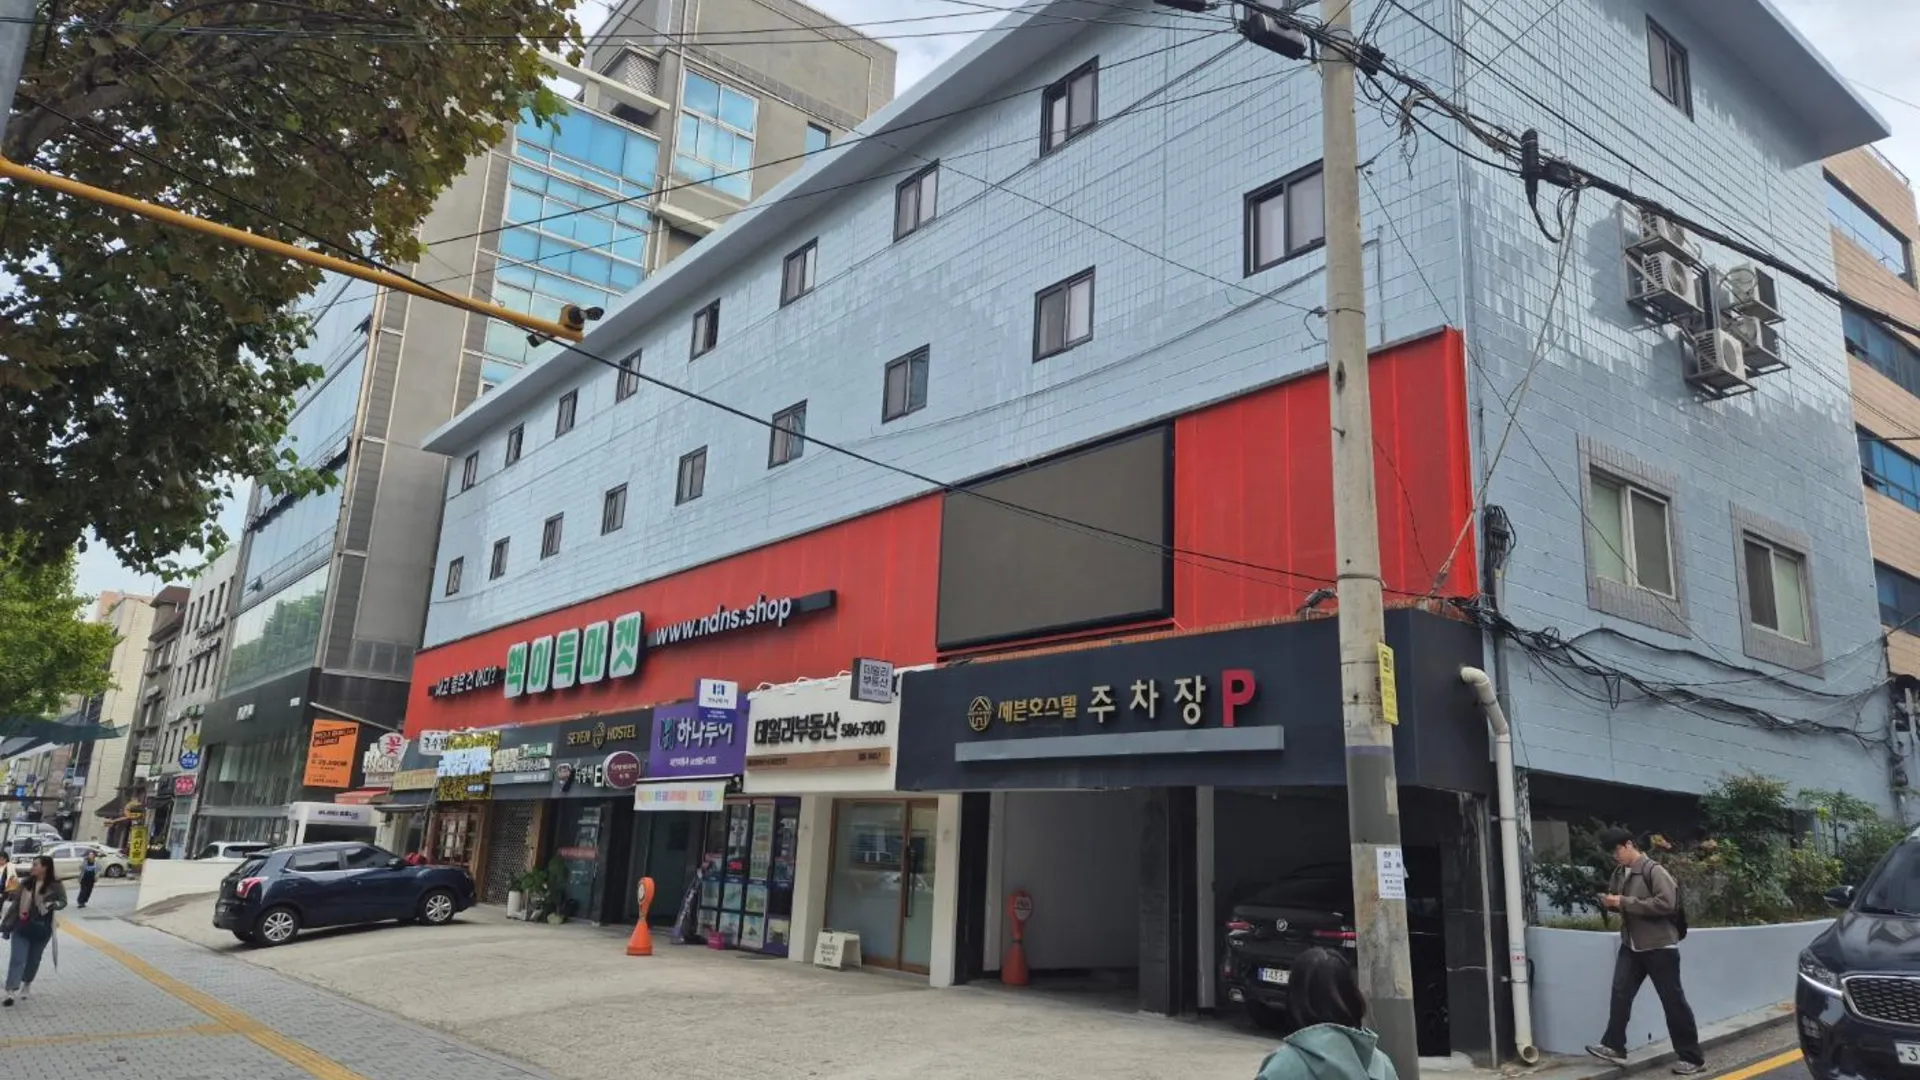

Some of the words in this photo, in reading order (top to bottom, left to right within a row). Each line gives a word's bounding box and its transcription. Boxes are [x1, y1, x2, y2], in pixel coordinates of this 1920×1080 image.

[656, 596, 792, 646] www.ndns.shop
[506, 613, 640, 696] 핵이득마켓
[863, 675, 889, 688] 부동산
[998, 693, 1077, 723] 세븐호스텔
[1221, 669, 1256, 728] P
[386, 735, 401, 755] 꽃
[567, 729, 591, 745] SEVEN
[606, 724, 636, 740] HOSTEL
[754, 711, 840, 745] 데일리부동산
[840, 720, 886, 737] 586-7300
